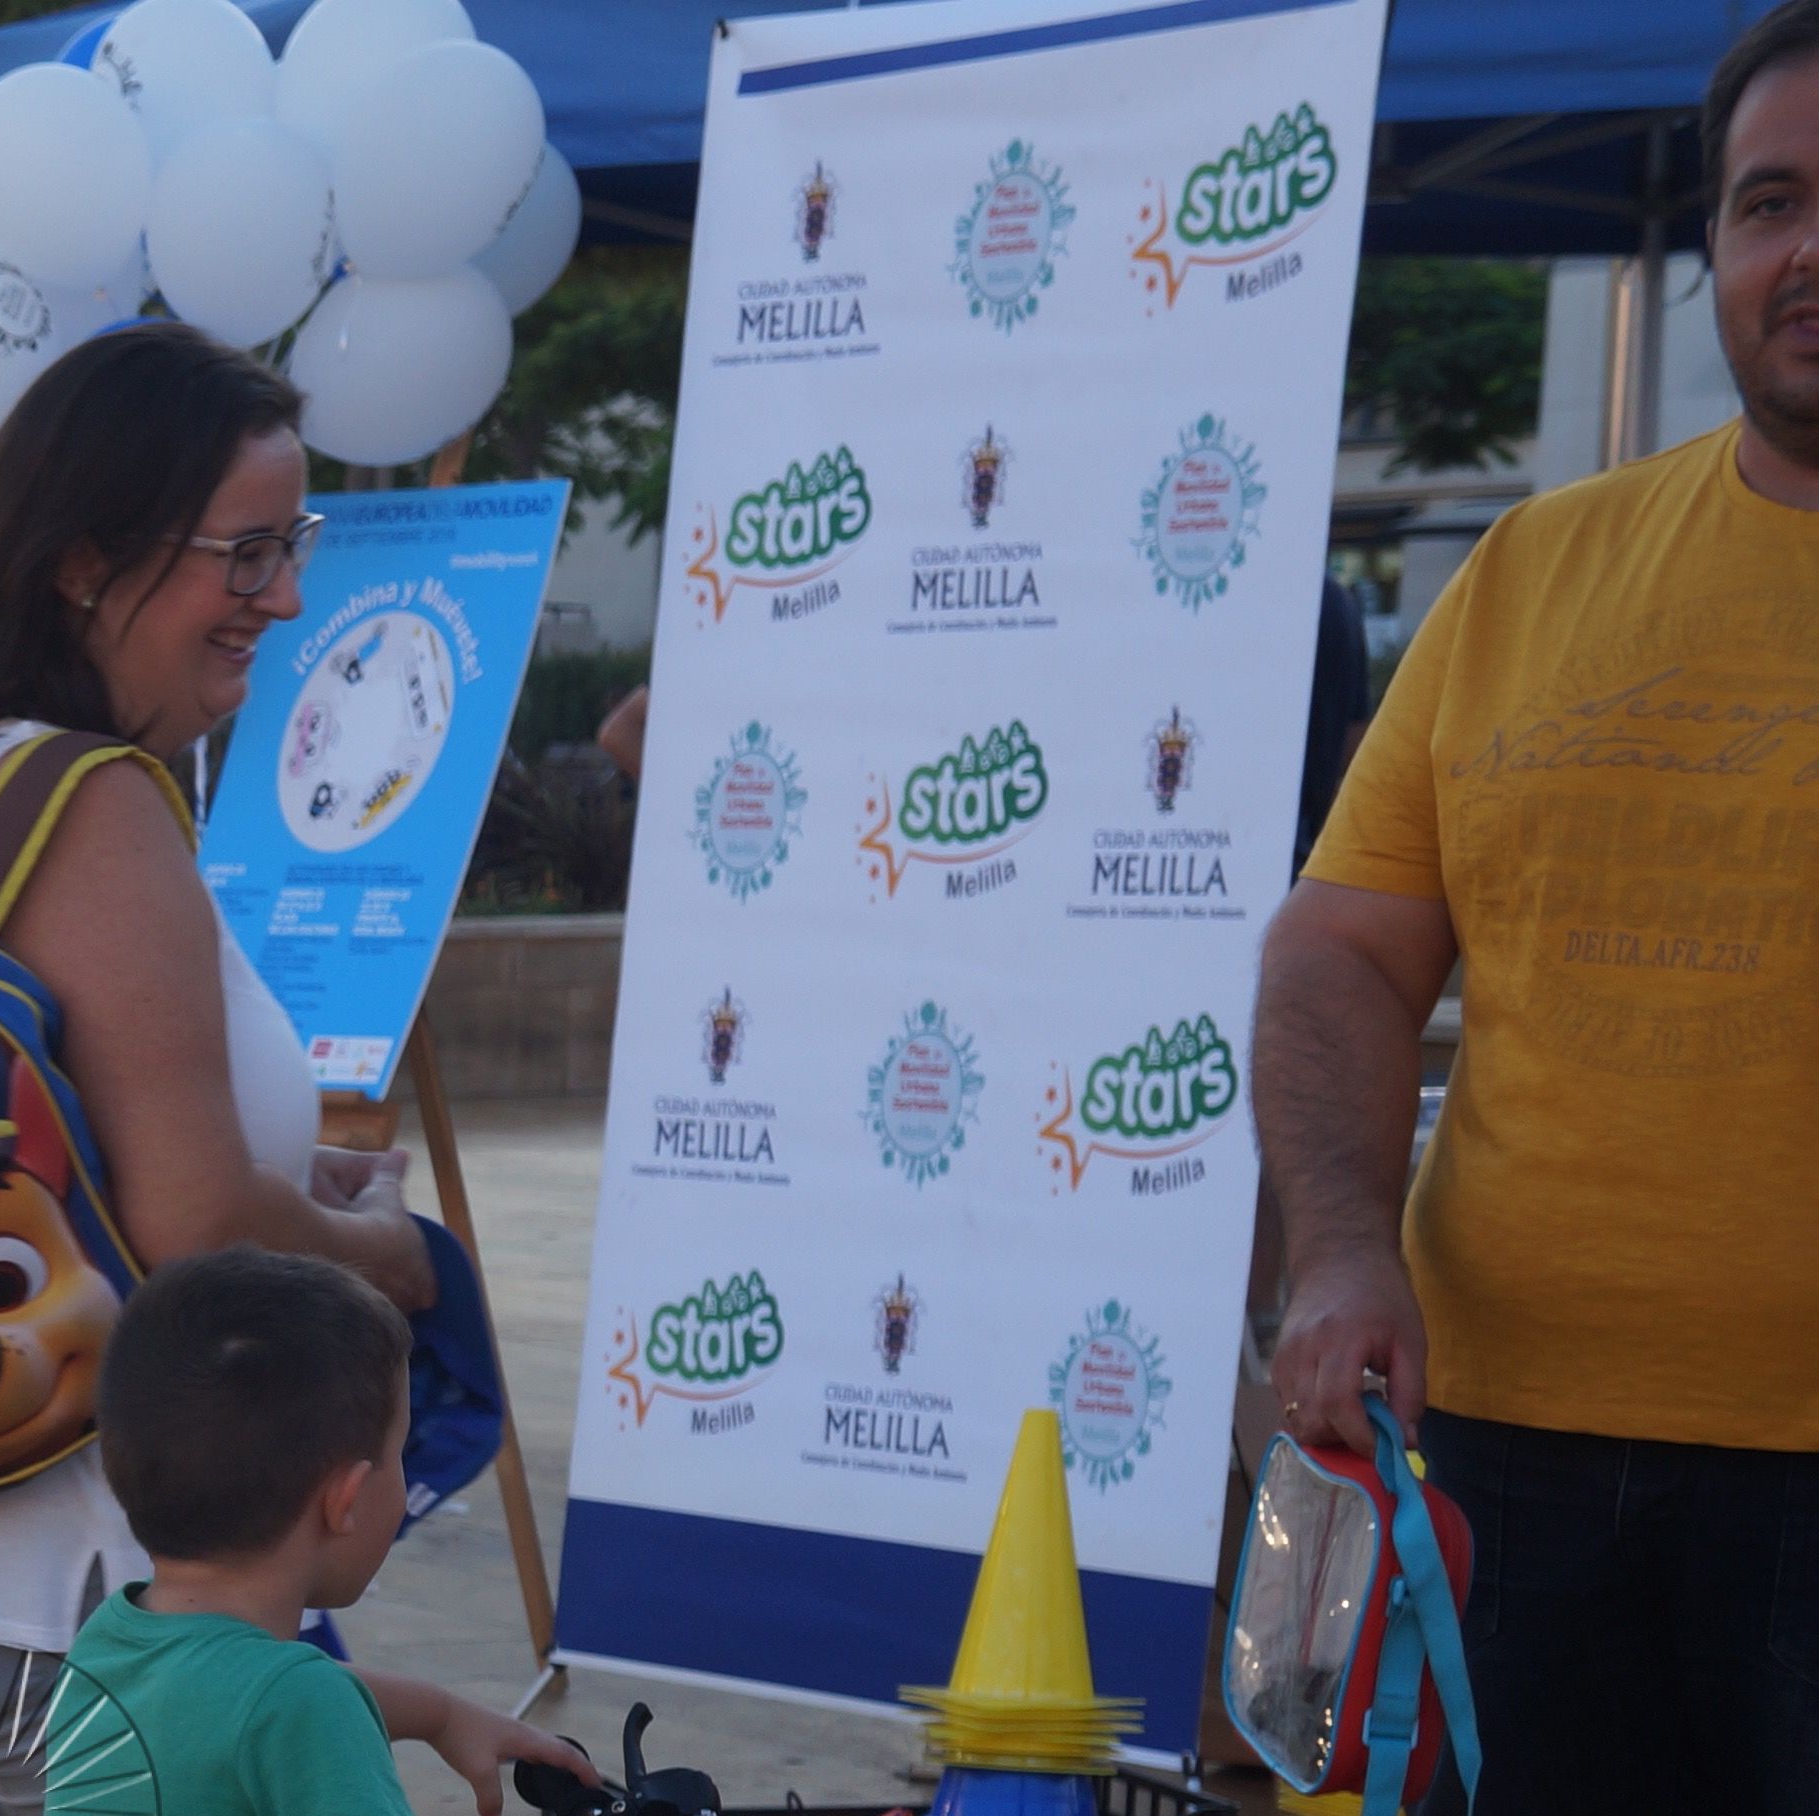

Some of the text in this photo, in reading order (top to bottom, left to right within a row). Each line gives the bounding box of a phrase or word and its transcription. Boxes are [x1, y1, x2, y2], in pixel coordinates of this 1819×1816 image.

[1176, 128, 1337, 243] stars
[1226, 253, 1303, 302] Melilla
[738, 298, 865, 343] MELILLA
[726, 470, 871, 568] stars
[399, 580, 418, 607] y
[772, 580, 841, 621] Melilla
[912, 567, 1039, 610] MELILLA
[1450, 720, 1784, 782] National
[900, 747, 1047, 843] stars
[946, 860, 1017, 898] Melilla
[1092, 854, 1227, 896] MELILLA
[1082, 1043, 1236, 1137] stars
[654, 1118, 775, 1163] MELILLA
[1132, 1158, 1205, 1196] Melilla
[647, 1297, 783, 1380] stars
[691, 1402, 755, 1434] Melilla
[824, 1405, 949, 1459] MELILLA
